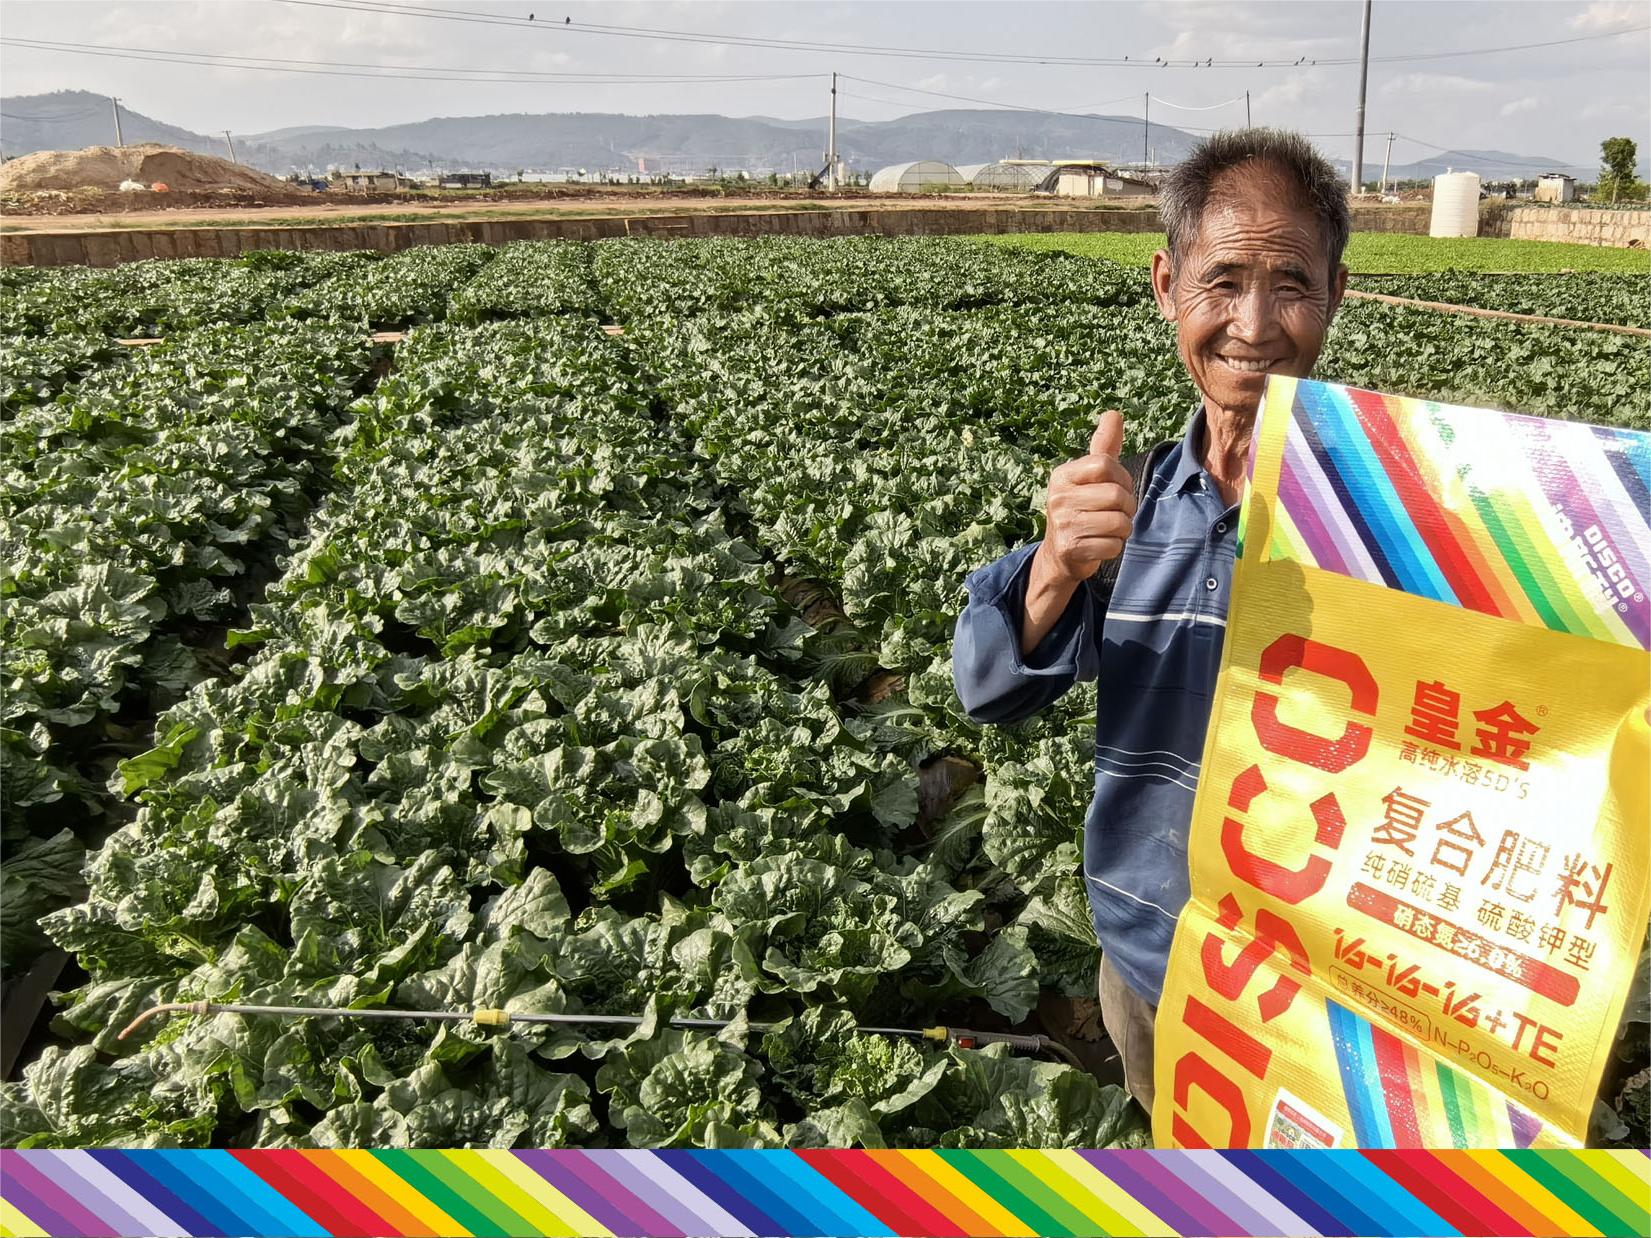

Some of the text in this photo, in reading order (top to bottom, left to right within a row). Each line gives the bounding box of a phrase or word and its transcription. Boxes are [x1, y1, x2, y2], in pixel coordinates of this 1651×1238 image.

[1583, 524, 1636, 599] DISCO
[1403, 679, 1541, 772] 皇金
[1172, 633, 1380, 1148] DISCO
[1371, 786, 1614, 931] 复合肥料
[1476, 898, 1598, 972] 硫酸钾型
